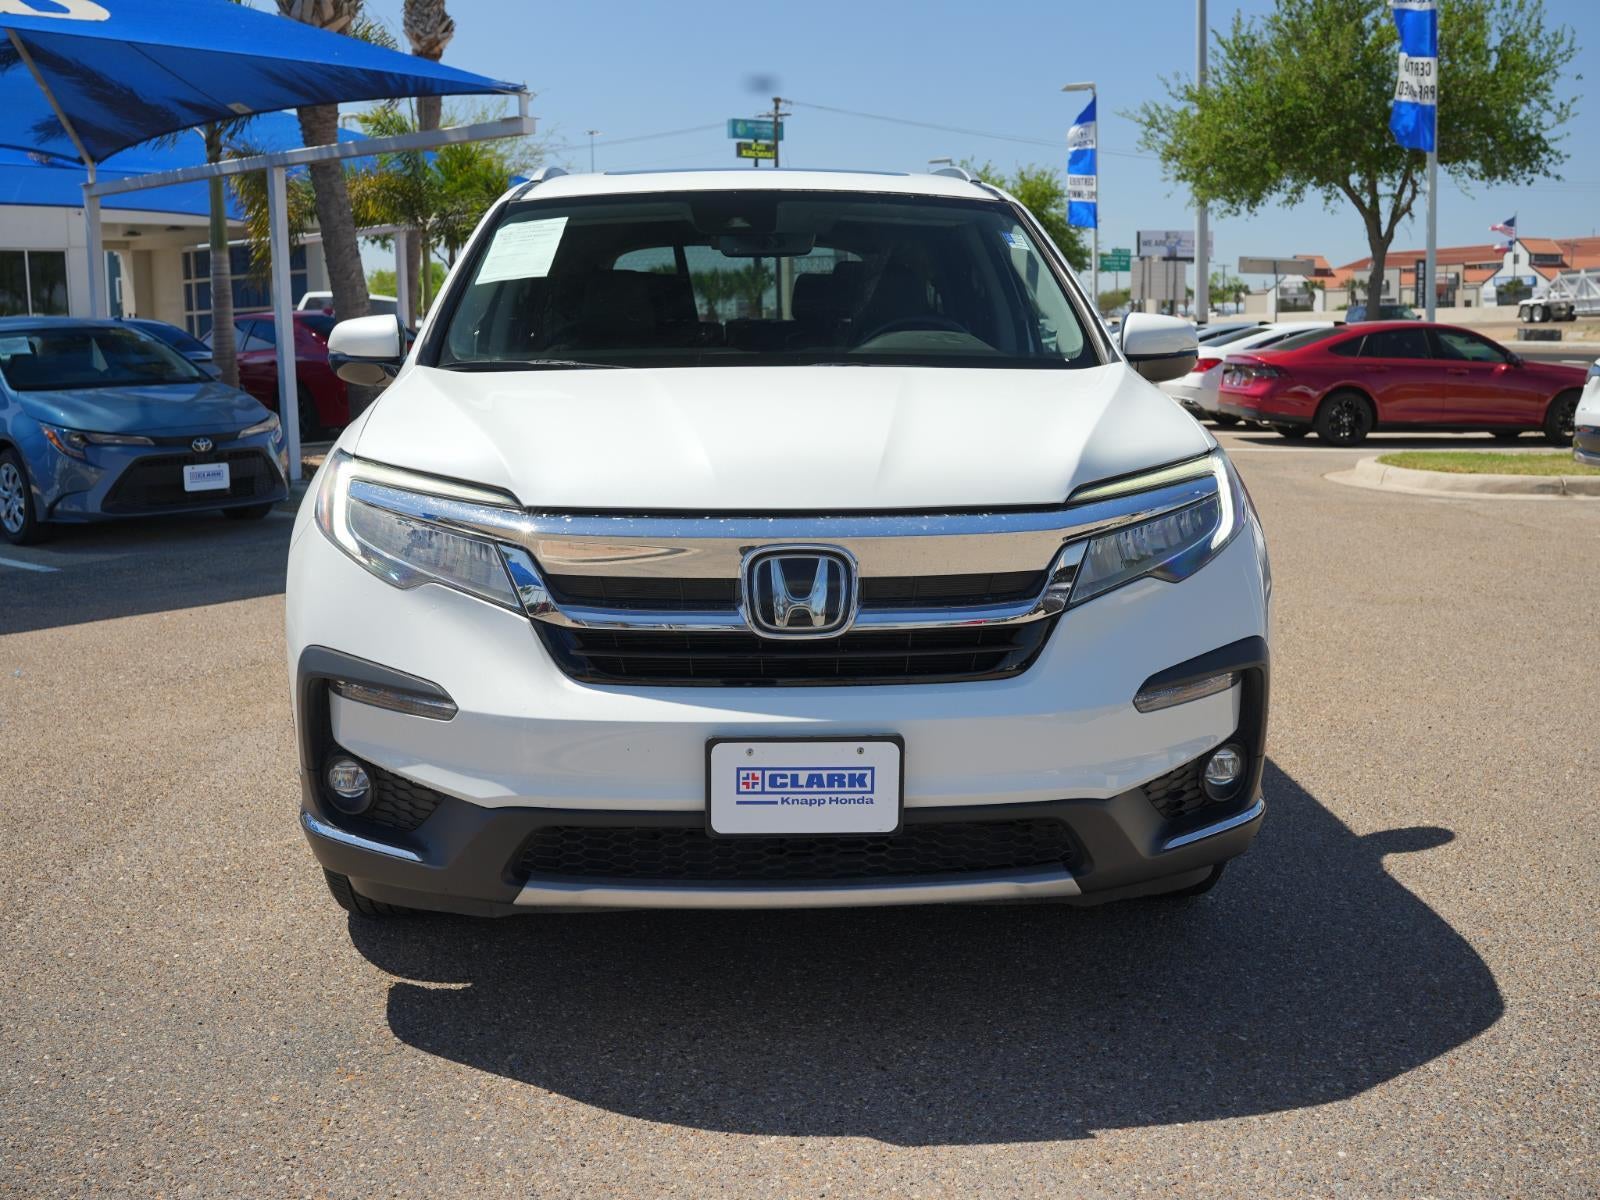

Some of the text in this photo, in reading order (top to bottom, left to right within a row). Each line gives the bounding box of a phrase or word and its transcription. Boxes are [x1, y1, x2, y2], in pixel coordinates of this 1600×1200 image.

[768, 773, 868, 788] CLARK
[780, 796, 875, 807] Knapp Honda
